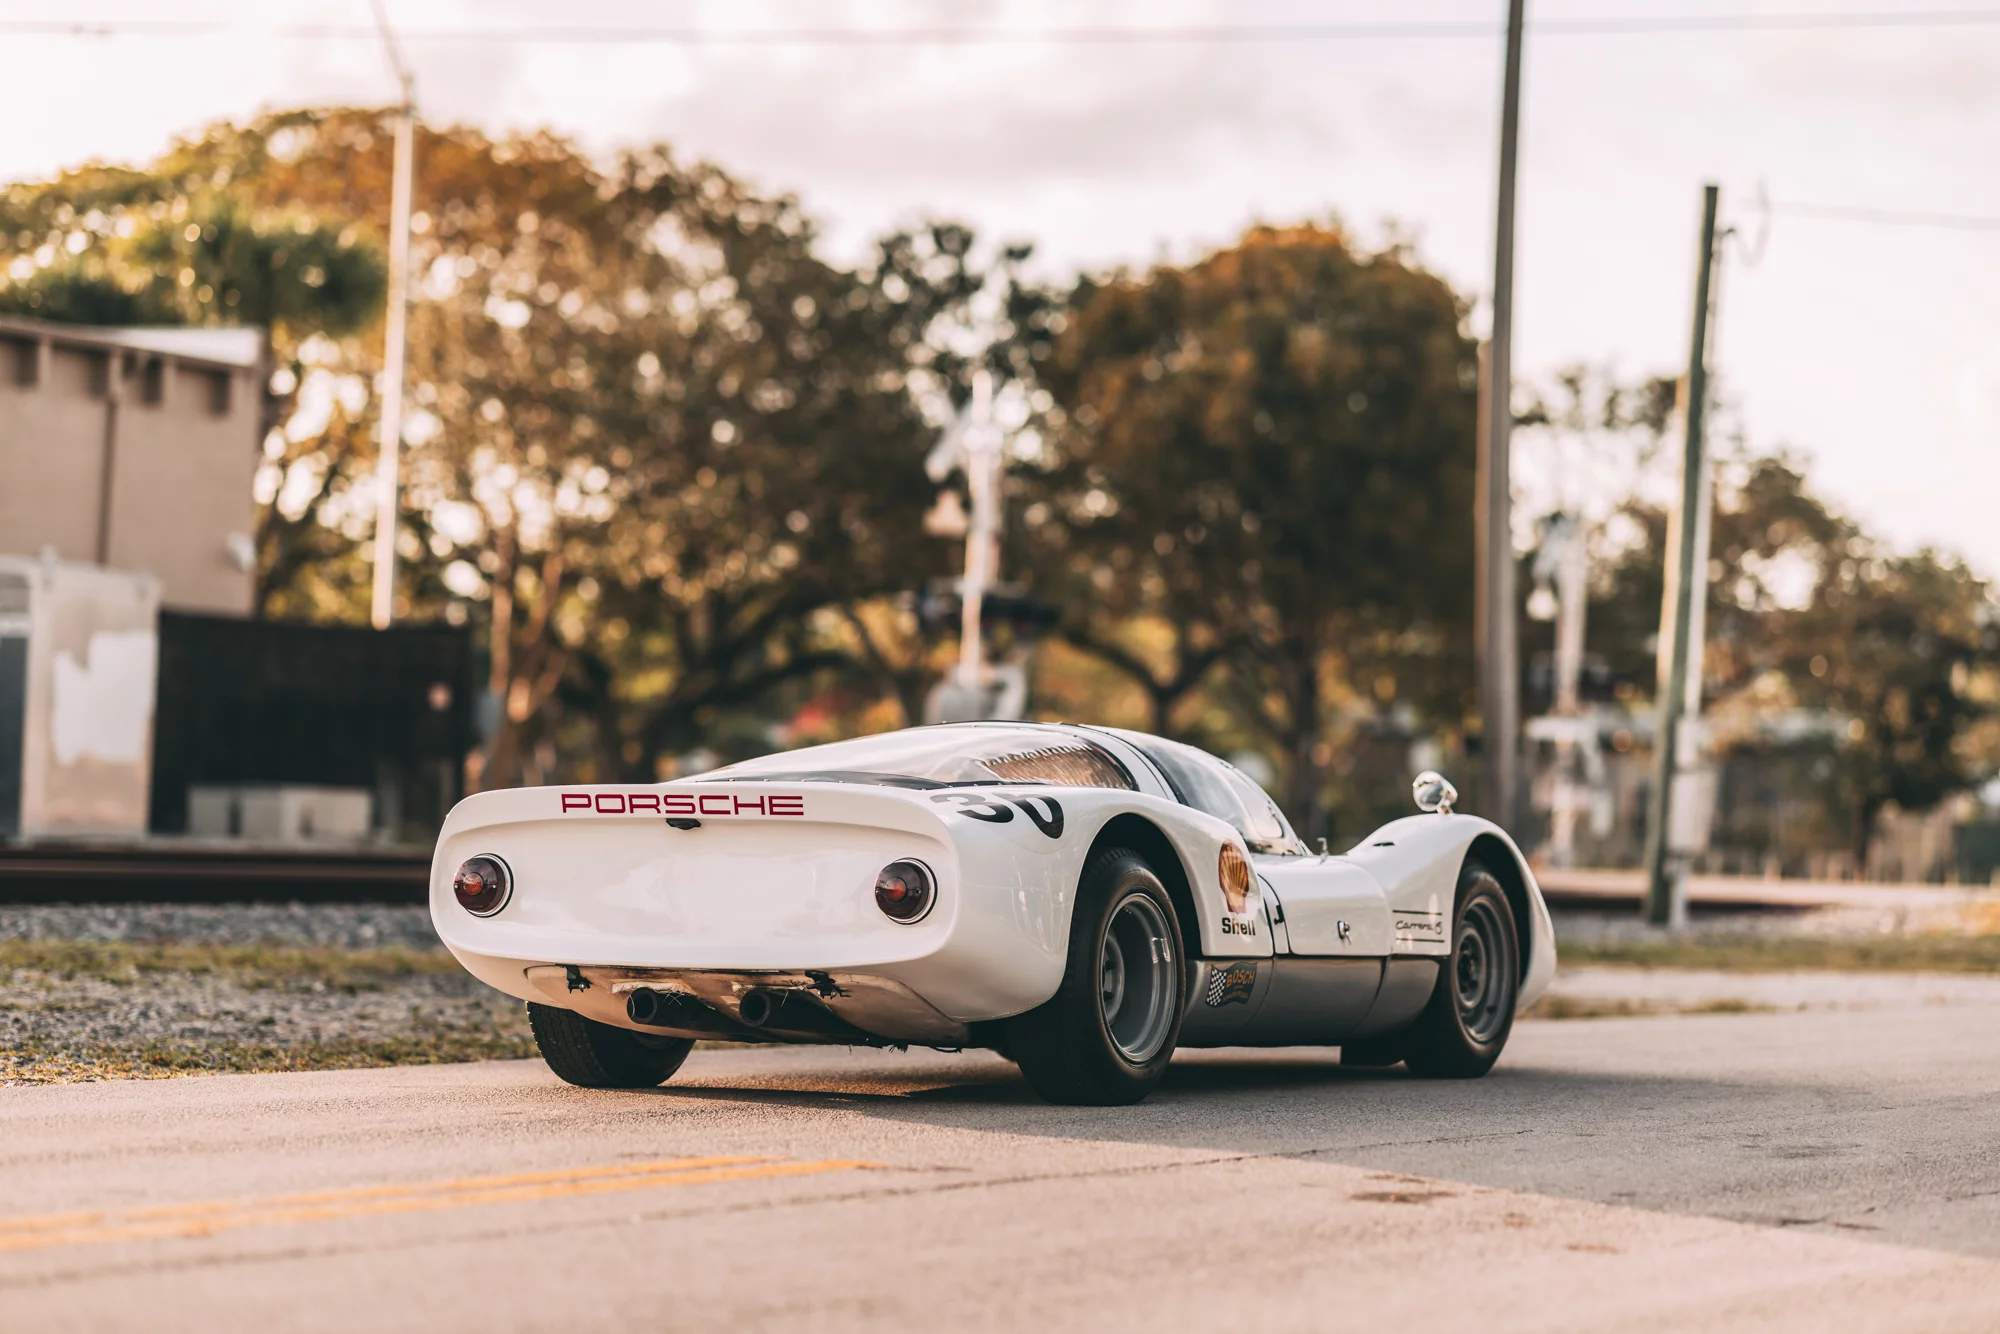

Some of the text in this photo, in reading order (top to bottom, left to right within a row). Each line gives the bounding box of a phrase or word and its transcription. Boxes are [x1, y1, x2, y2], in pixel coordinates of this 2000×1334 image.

[561, 794, 804, 815] PORSCHE
[1221, 917, 1256, 936] Shell
[1395, 920, 1443, 935] Carrera 6
[1226, 969, 1255, 988] BOSCH
